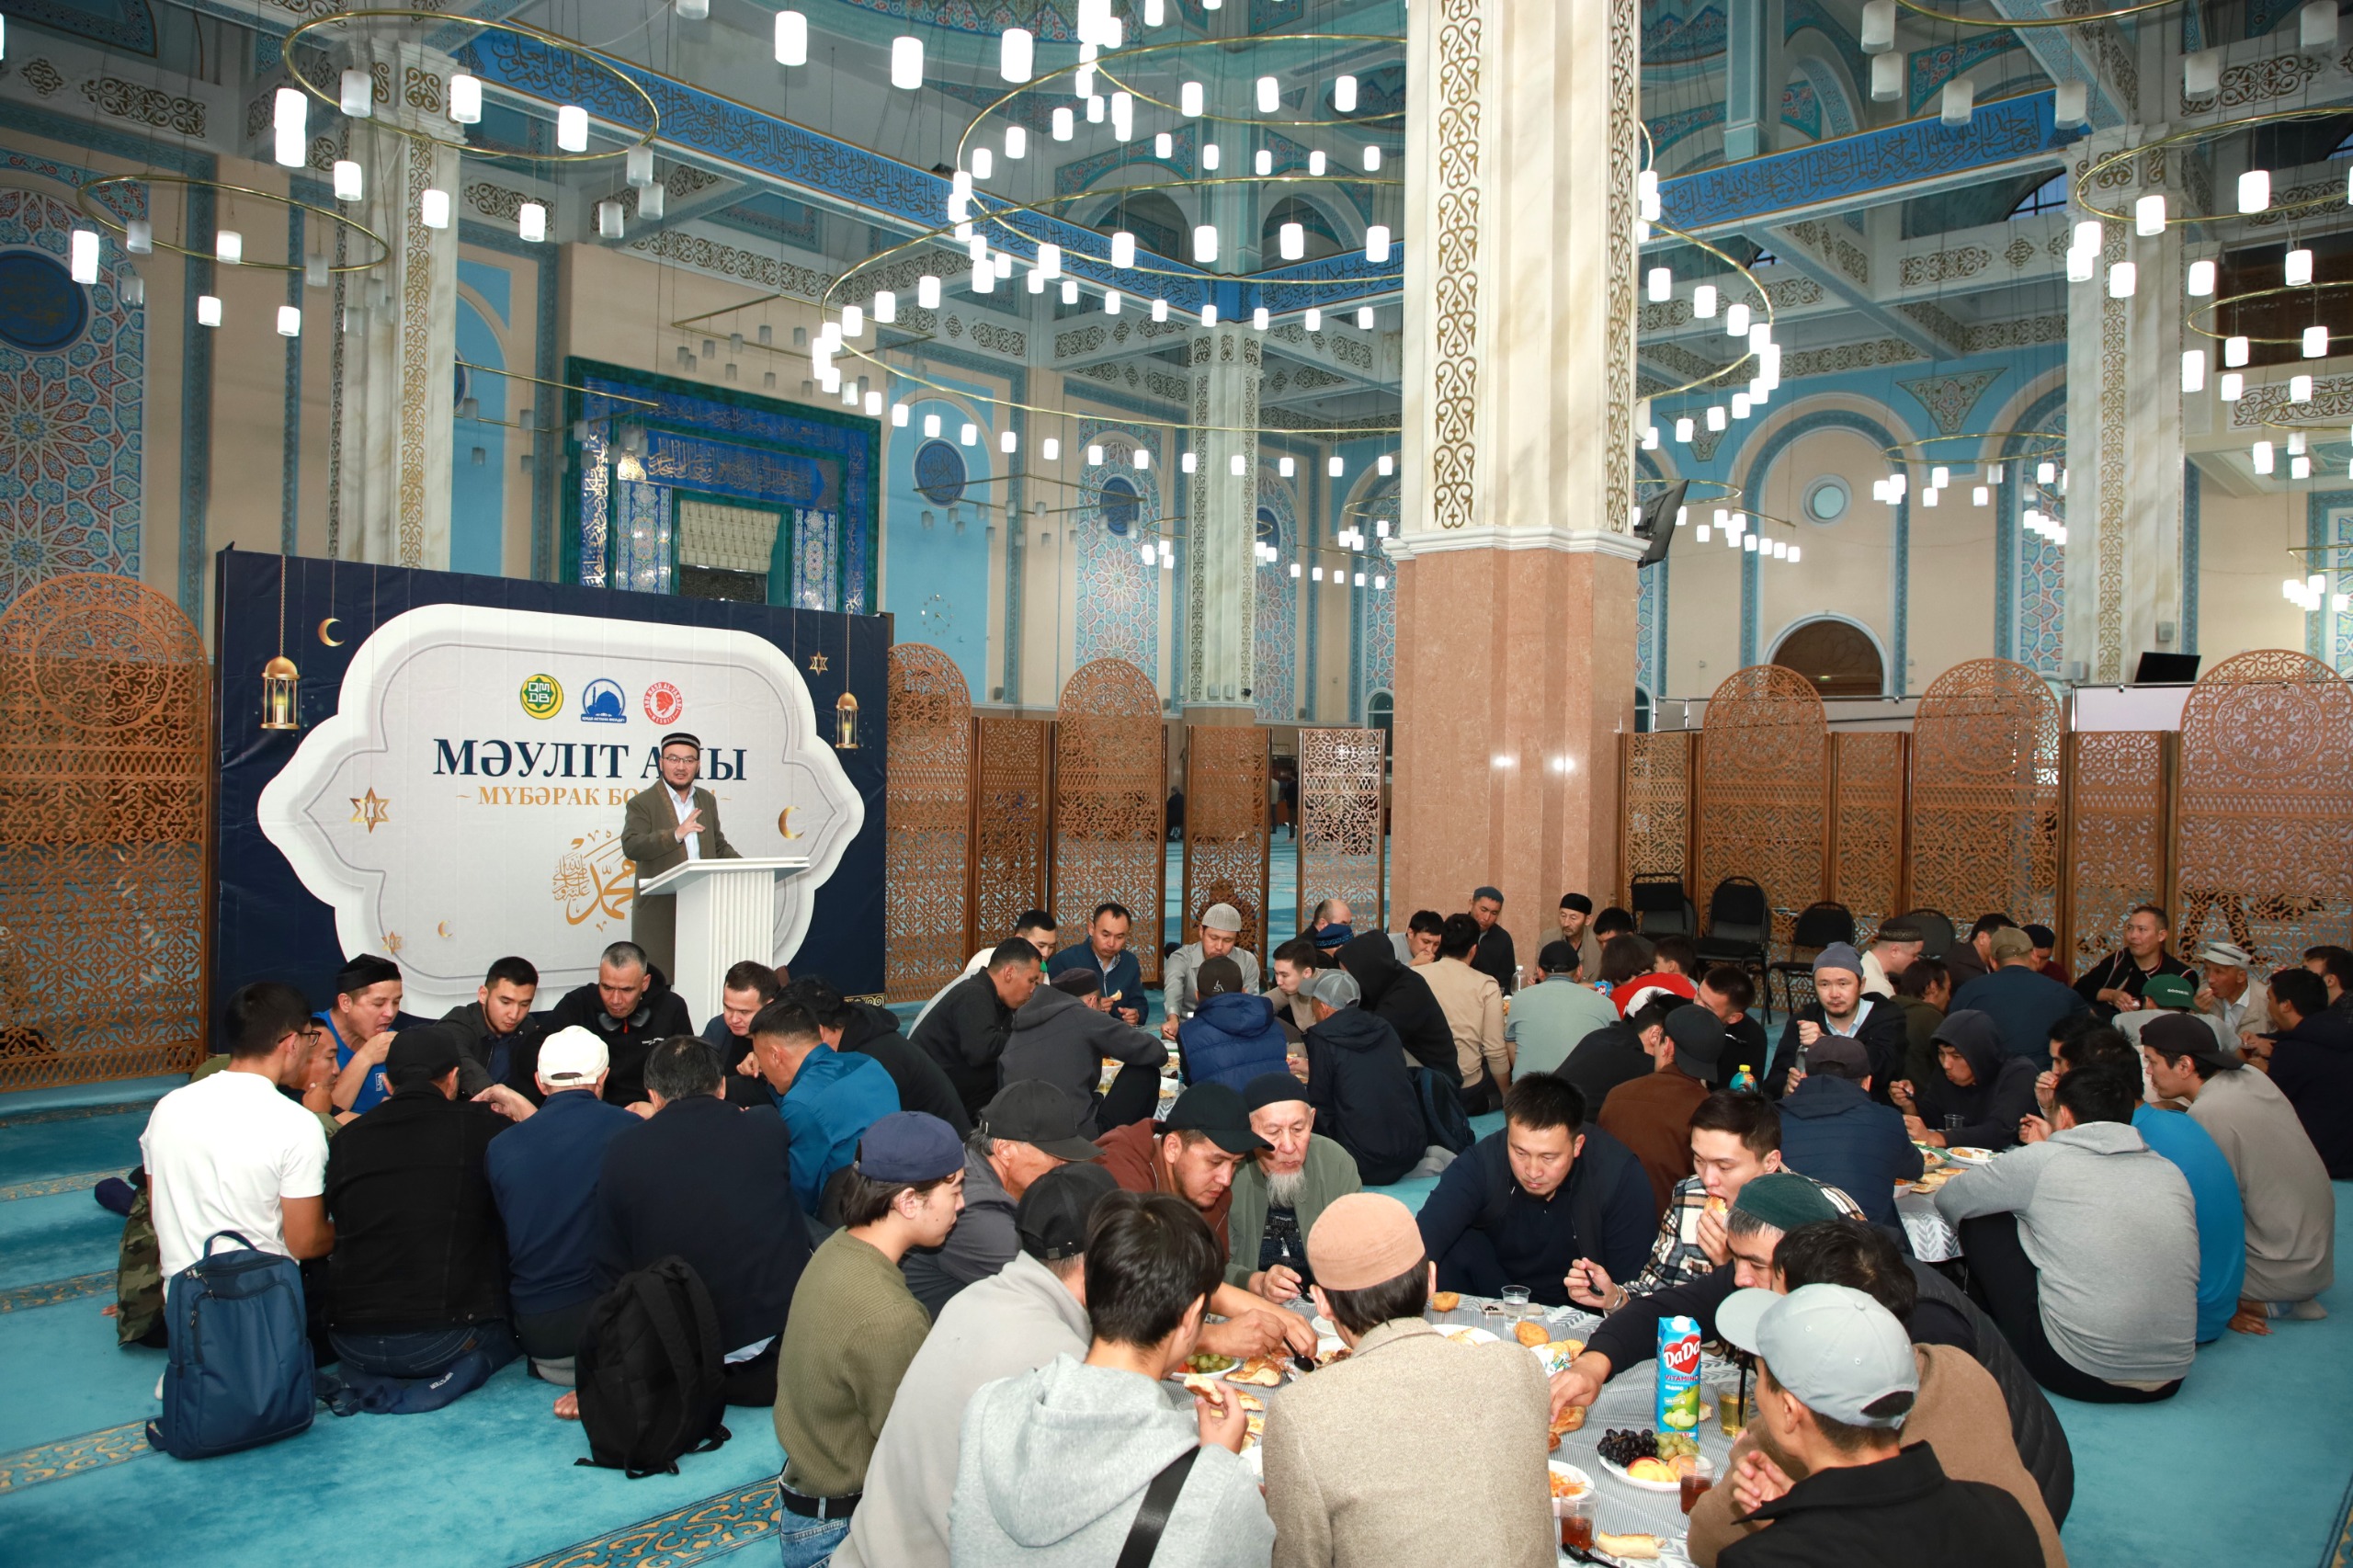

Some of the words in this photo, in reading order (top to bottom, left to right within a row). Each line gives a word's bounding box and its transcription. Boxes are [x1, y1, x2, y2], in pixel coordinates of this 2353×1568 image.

[433, 738, 629, 779] МӘУЛІТ
[641, 745, 747, 781] АЫ
[478, 786, 600, 806] МҮБӘРАК
[1664, 1340, 1700, 1369] DaDa
